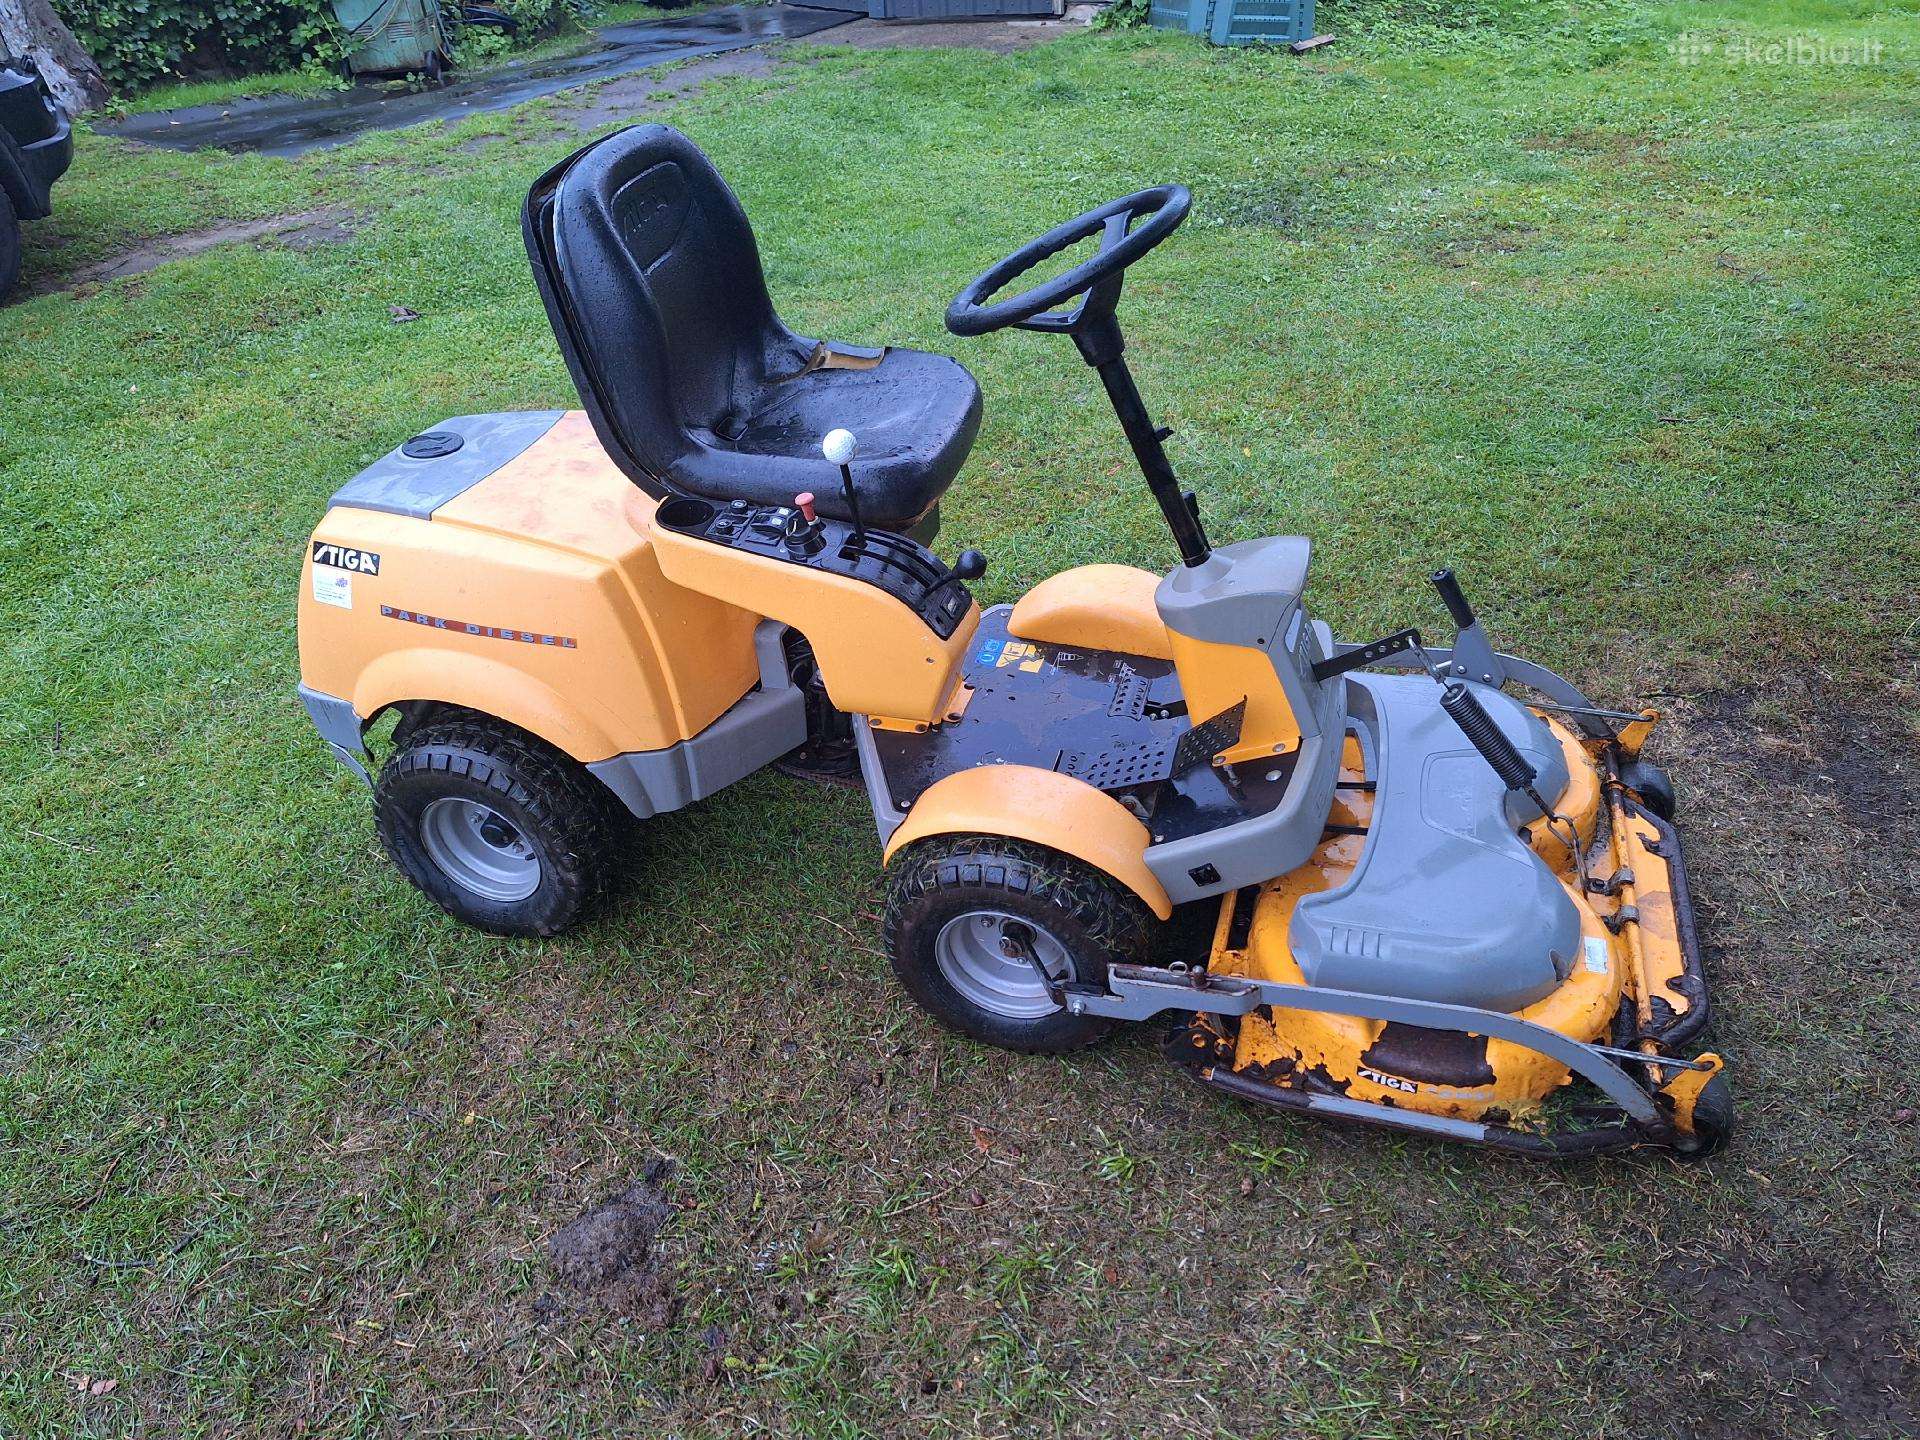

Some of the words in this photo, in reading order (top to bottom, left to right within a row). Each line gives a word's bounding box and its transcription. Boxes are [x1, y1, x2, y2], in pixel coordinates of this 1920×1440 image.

[313, 544, 378, 574] STIGA
[381, 606, 447, 629] PARK
[466, 623, 577, 649] DIESEL
[1358, 1070, 1416, 1093] STIGA
